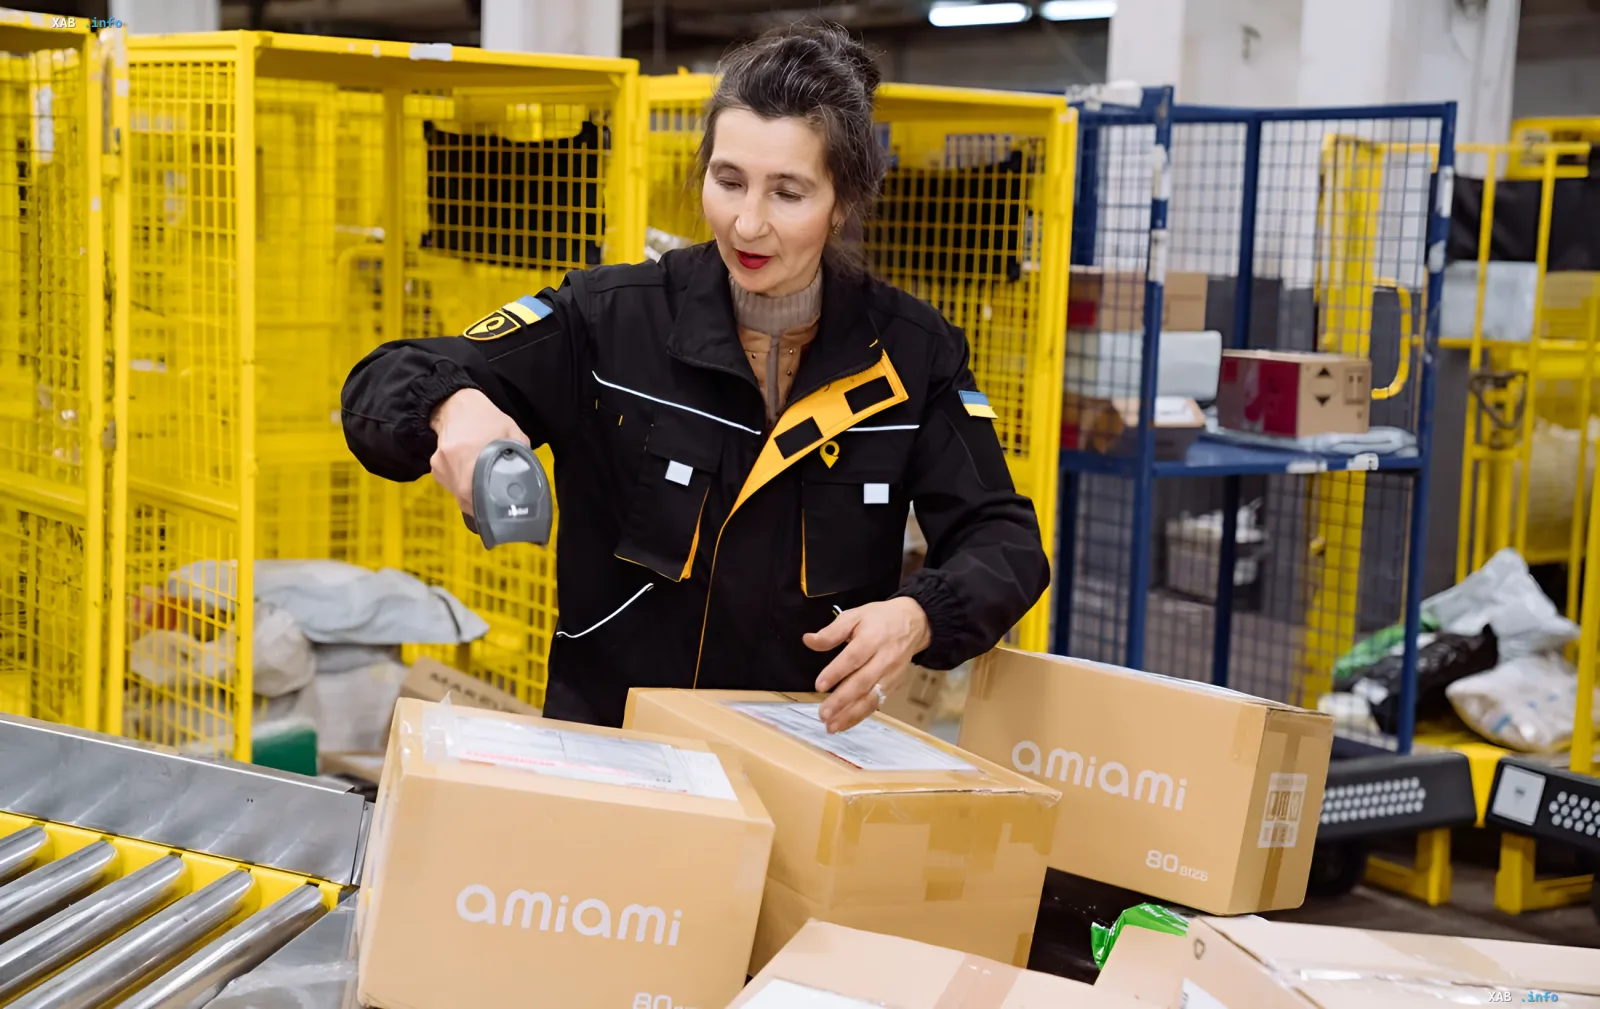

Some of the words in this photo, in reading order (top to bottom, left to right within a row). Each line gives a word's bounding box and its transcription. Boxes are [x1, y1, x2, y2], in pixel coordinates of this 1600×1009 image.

[1012, 740, 1188, 811] amiami
[1145, 849, 1179, 873] 80
[456, 883, 683, 946] amiami
[632, 991, 673, 1009] 80
